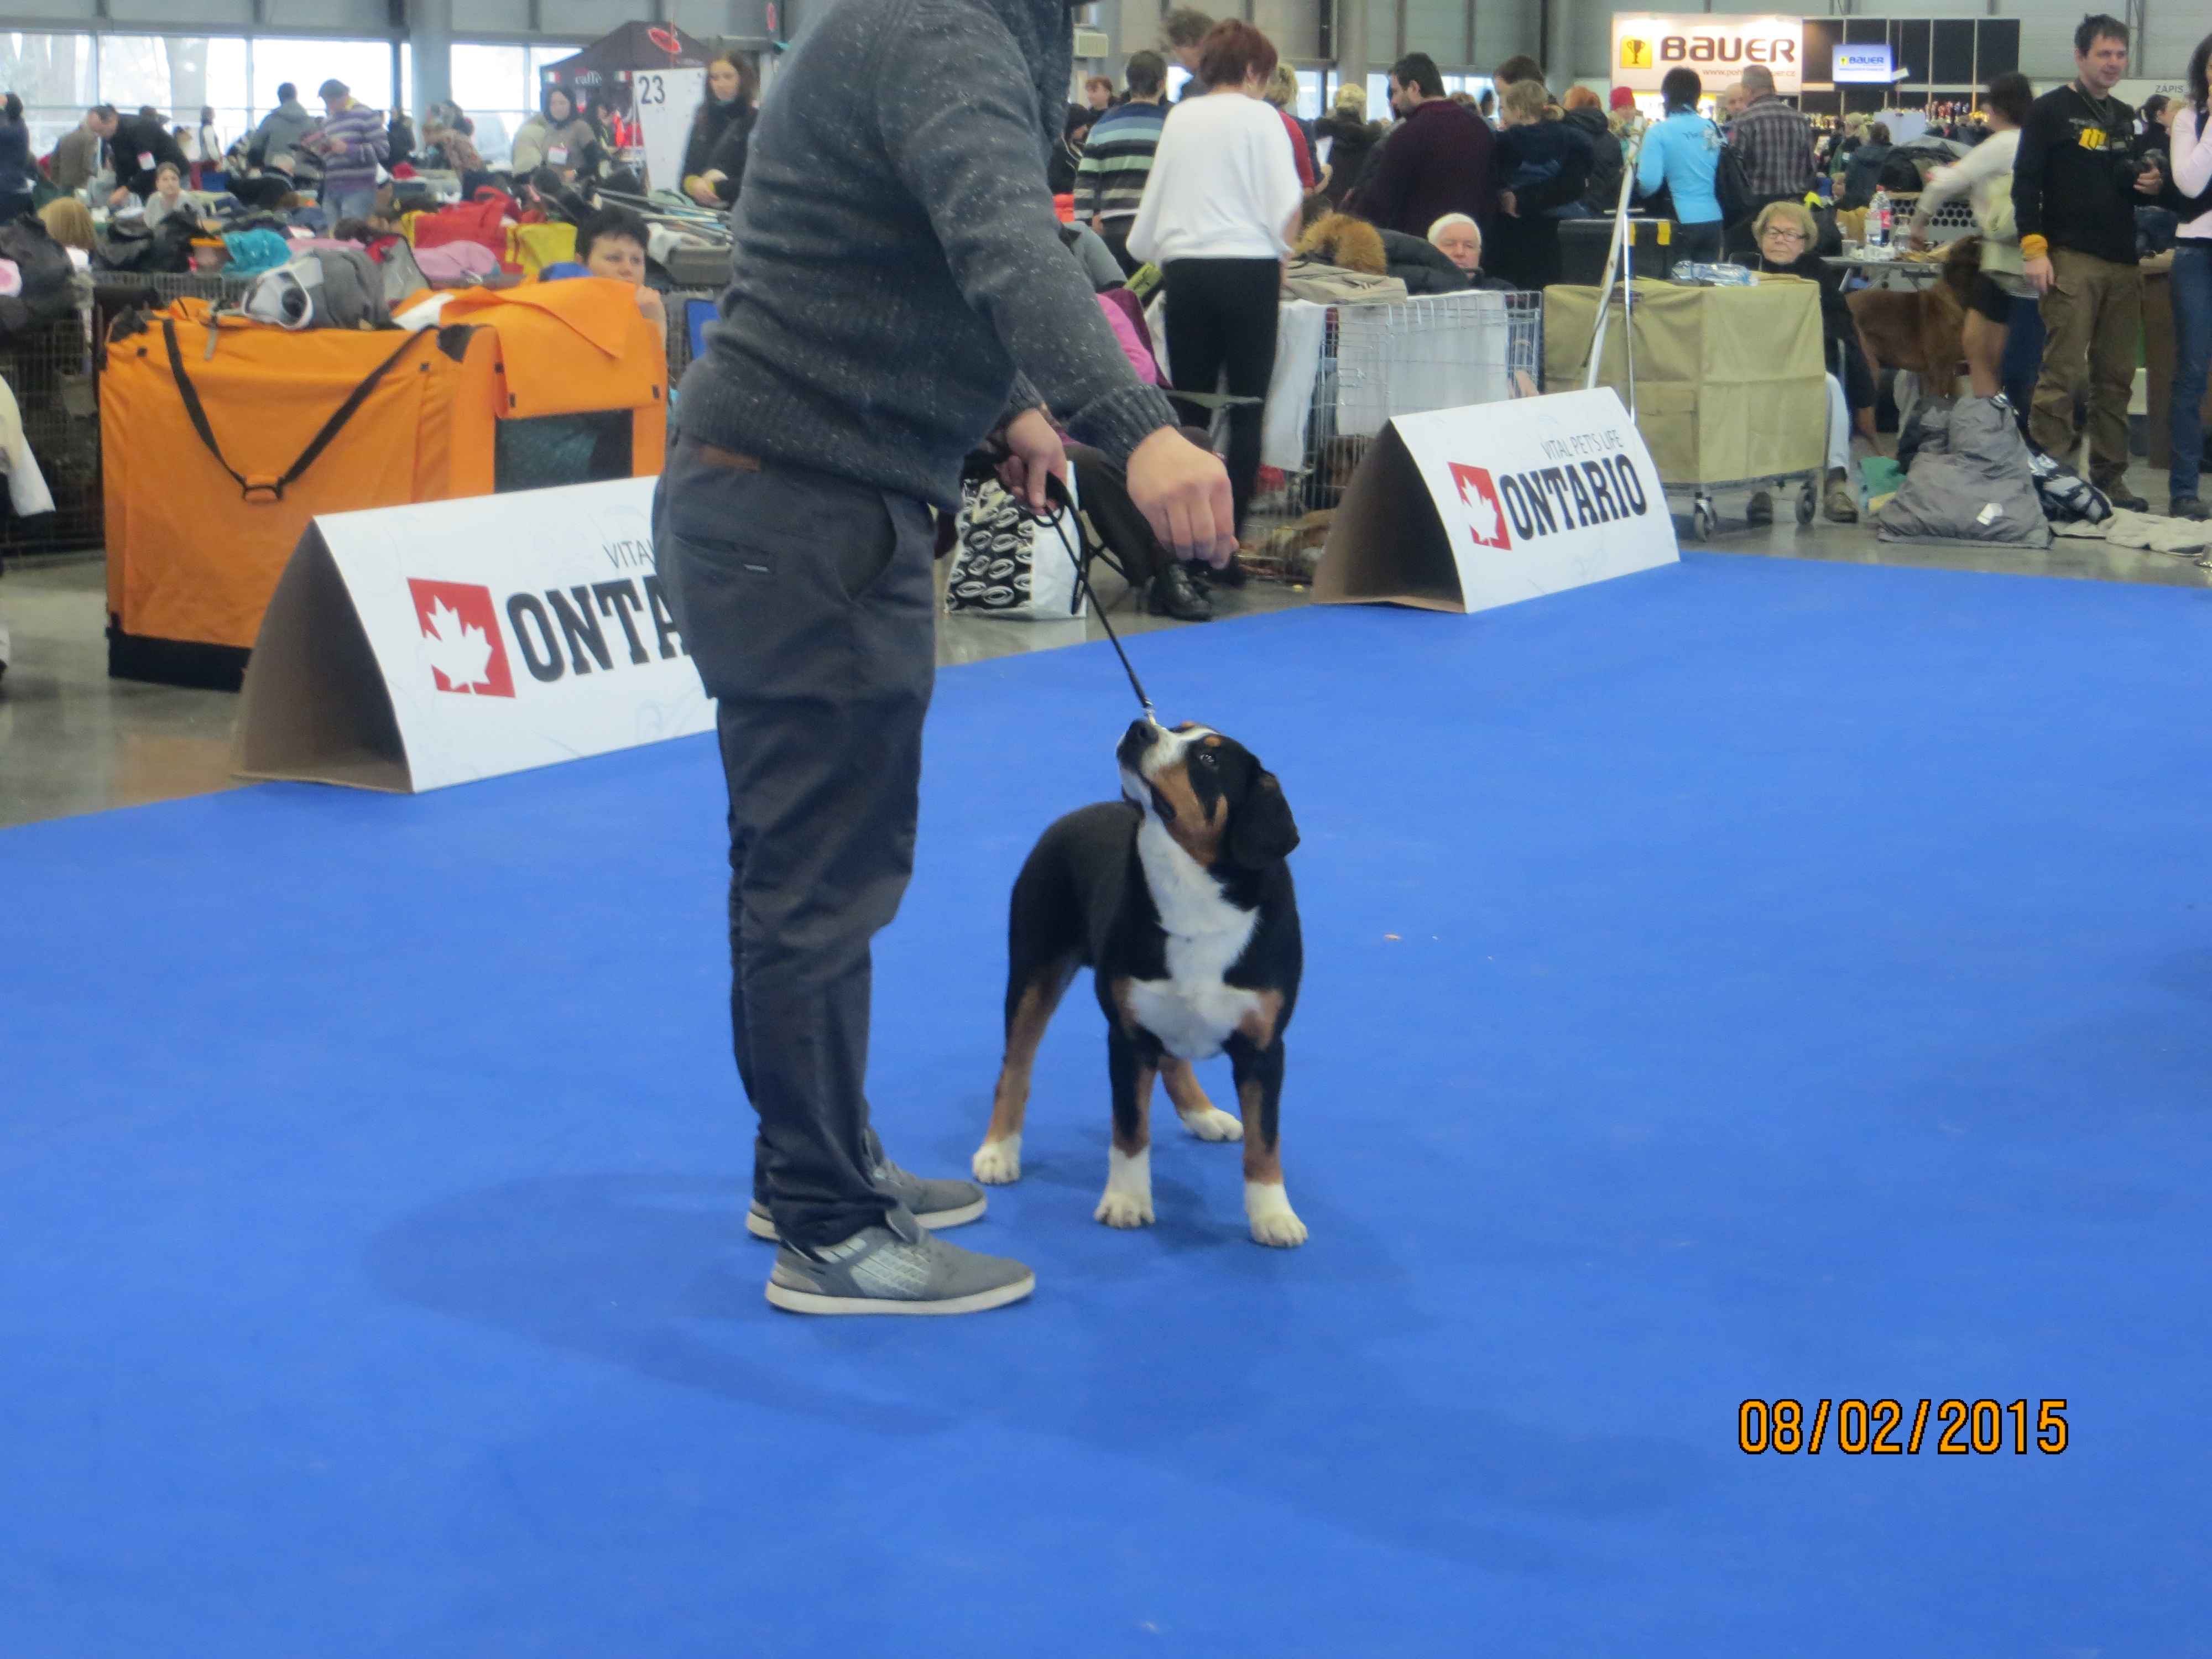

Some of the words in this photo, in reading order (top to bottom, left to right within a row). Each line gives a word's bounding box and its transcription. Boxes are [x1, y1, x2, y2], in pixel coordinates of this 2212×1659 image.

[639, 75, 665, 104] 23
[1541, 439, 1573, 460] VITAL
[1569, 433, 1602, 456] PET'S
[1599, 429, 1624, 450] LIFE
[1499, 453, 1647, 540] ONTARIO
[506, 574, 691, 682] ONTA
